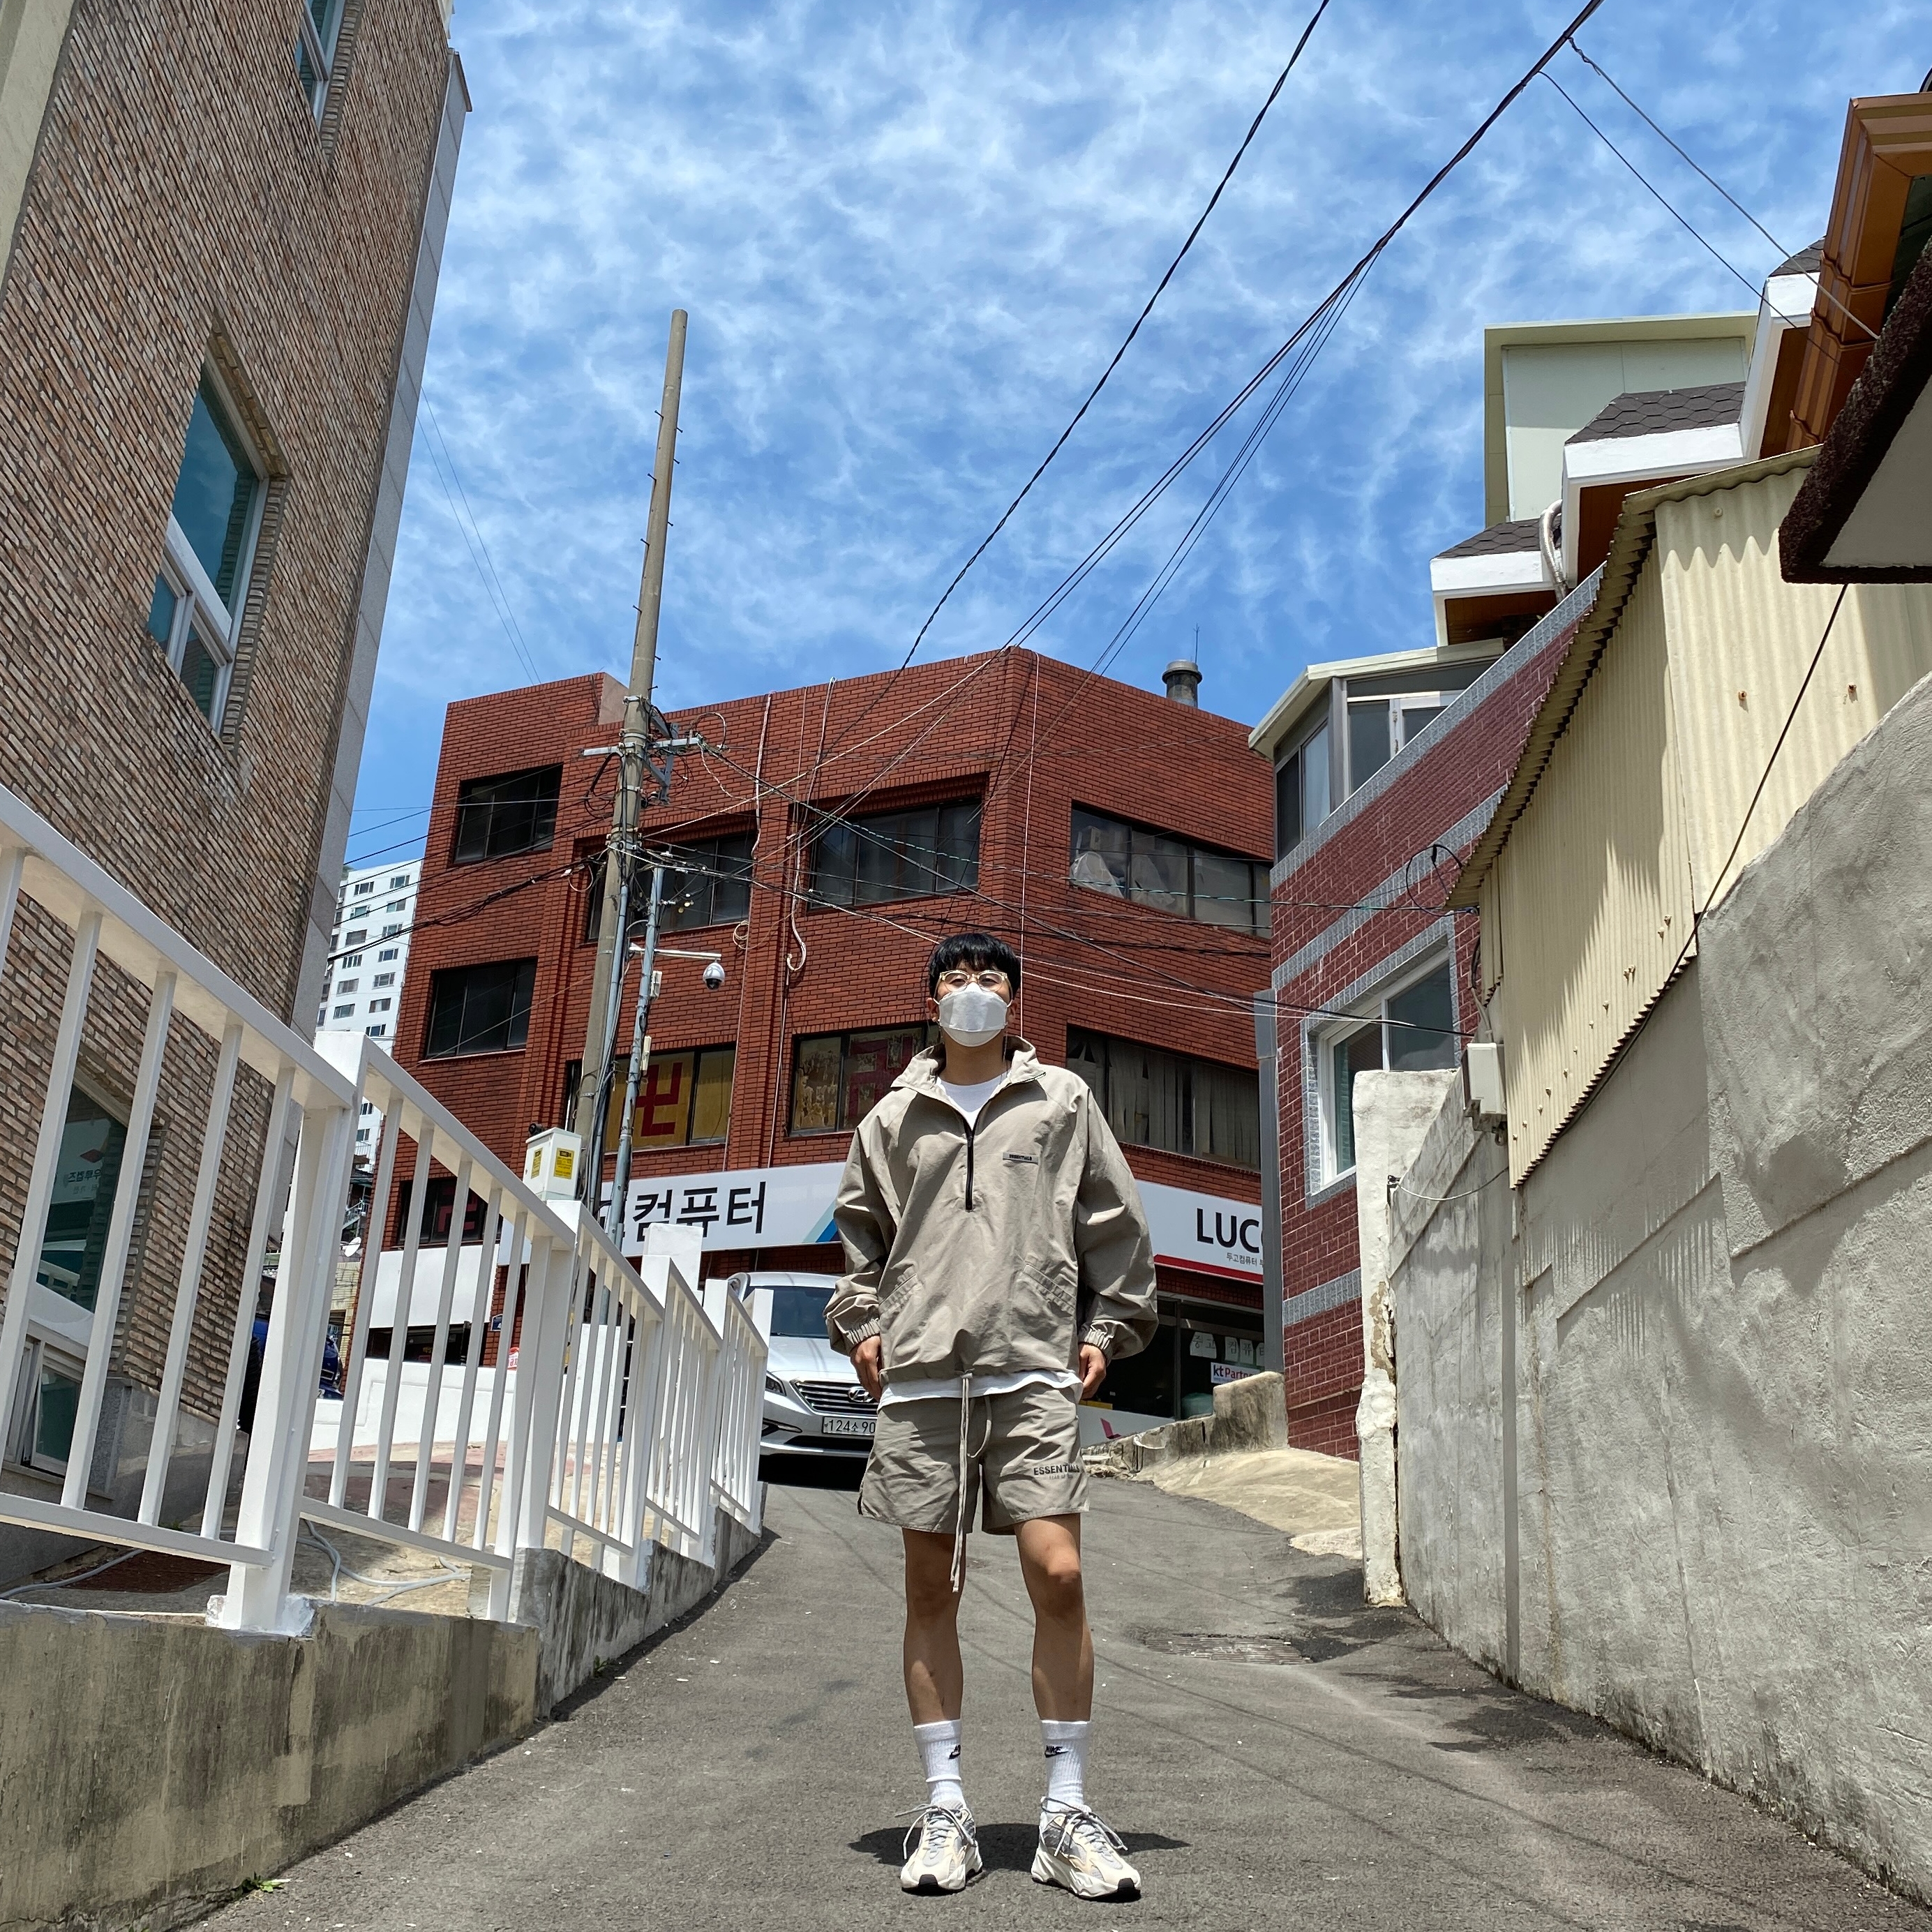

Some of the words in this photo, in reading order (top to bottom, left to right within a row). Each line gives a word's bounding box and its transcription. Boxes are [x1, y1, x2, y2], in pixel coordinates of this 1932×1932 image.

[600, 1181, 767, 1243] 컴퓨터
[1197, 1208, 1263, 1254] LUC
[828, 1419, 859, 1432] 124소
